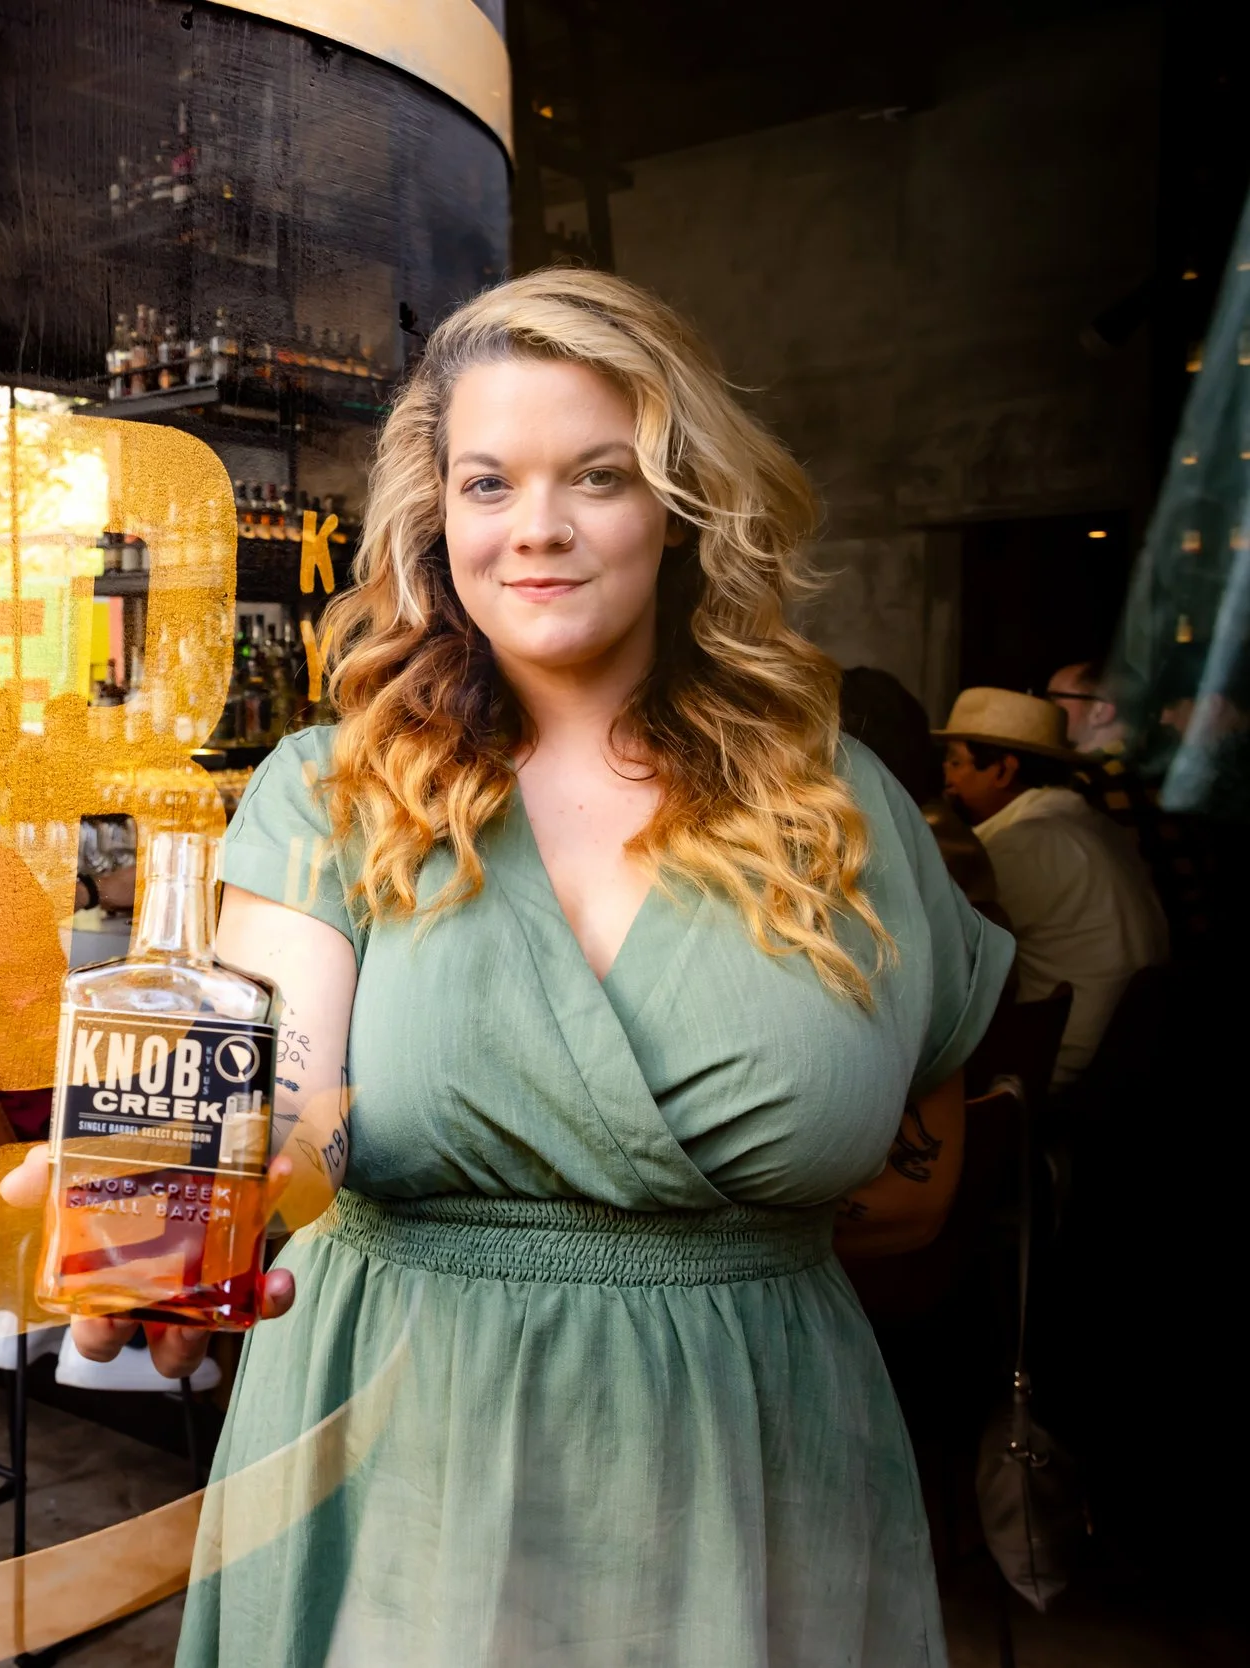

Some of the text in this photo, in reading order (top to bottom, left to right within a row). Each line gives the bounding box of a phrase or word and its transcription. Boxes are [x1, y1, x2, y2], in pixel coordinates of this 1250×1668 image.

[72, 1029, 203, 1097] KNOB
[93, 1091, 223, 1123] CREEK
[78, 1121, 106, 1133] SINGLE
[108, 1123, 138, 1136] BARREL
[141, 1127, 170, 1139] SELECT
[173, 1130, 211, 1144] BOURBON
[71, 1174, 231, 1204] KNOB CREEK
[69, 1195, 231, 1223] SMALL BATCH
